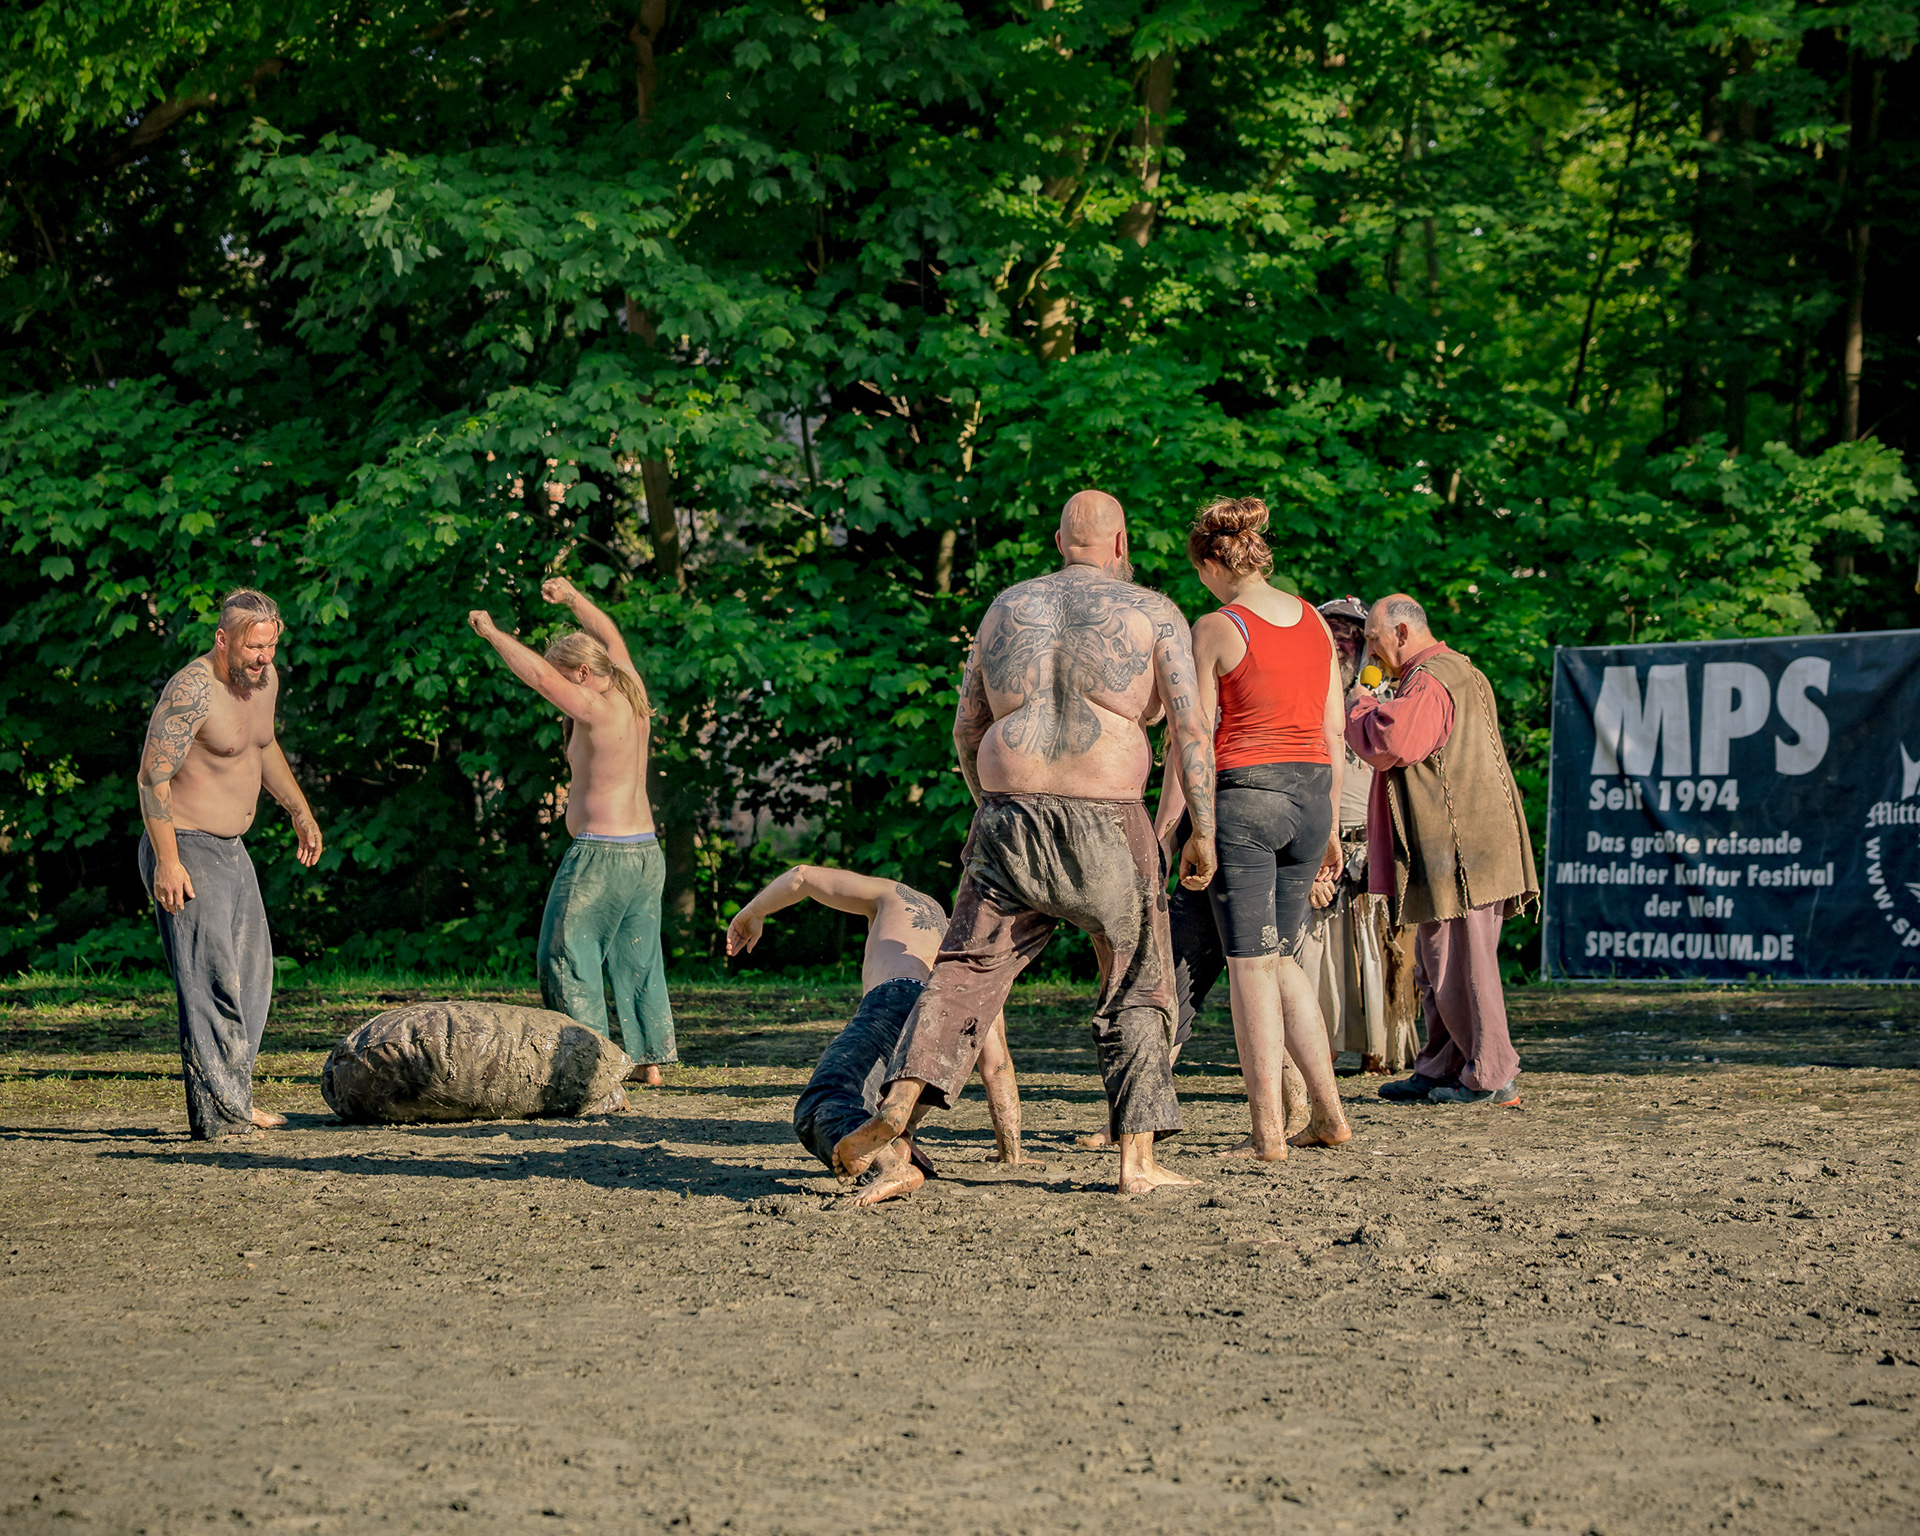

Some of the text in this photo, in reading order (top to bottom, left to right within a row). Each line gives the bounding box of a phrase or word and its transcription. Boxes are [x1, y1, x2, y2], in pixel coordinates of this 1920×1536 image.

[1157, 622, 1191, 711] Diem
[1590, 656, 1831, 777] MPS
[1588, 778, 1740, 812] Seit 1994
[1587, 830, 1802, 859] Das größte reisende
[1556, 862, 1834, 887] Mittelalter Kultur Festival
[1644, 894, 1734, 918] der Welt
[1585, 931, 1794, 961] SPECTACULUM.DE
